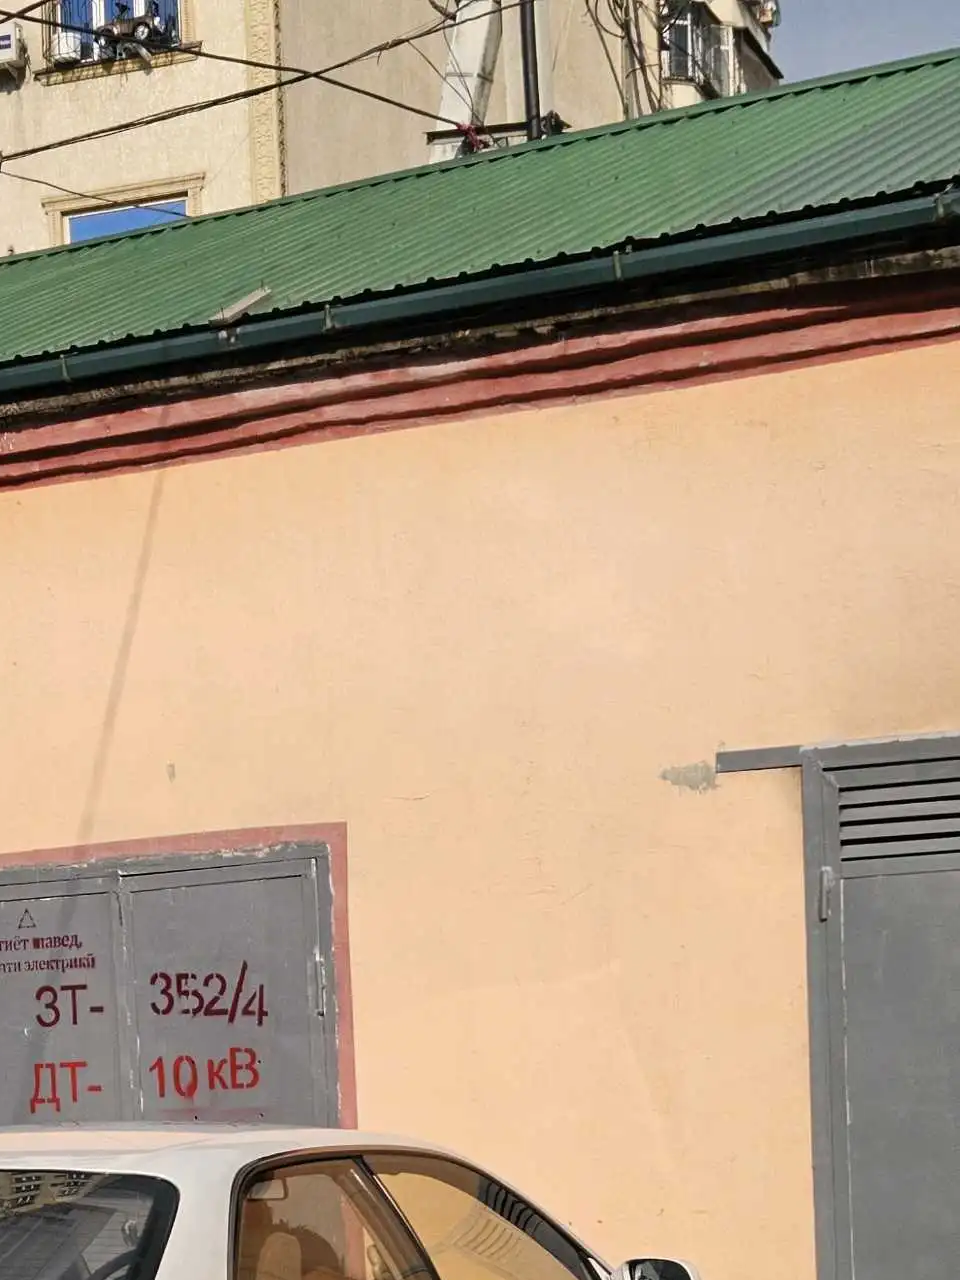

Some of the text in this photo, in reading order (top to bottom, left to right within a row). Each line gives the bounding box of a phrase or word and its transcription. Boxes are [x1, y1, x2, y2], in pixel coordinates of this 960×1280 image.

[150, 960, 268, 1027] 352/4
[30, 1047, 260, 1114] ДТ- 10 кВ
